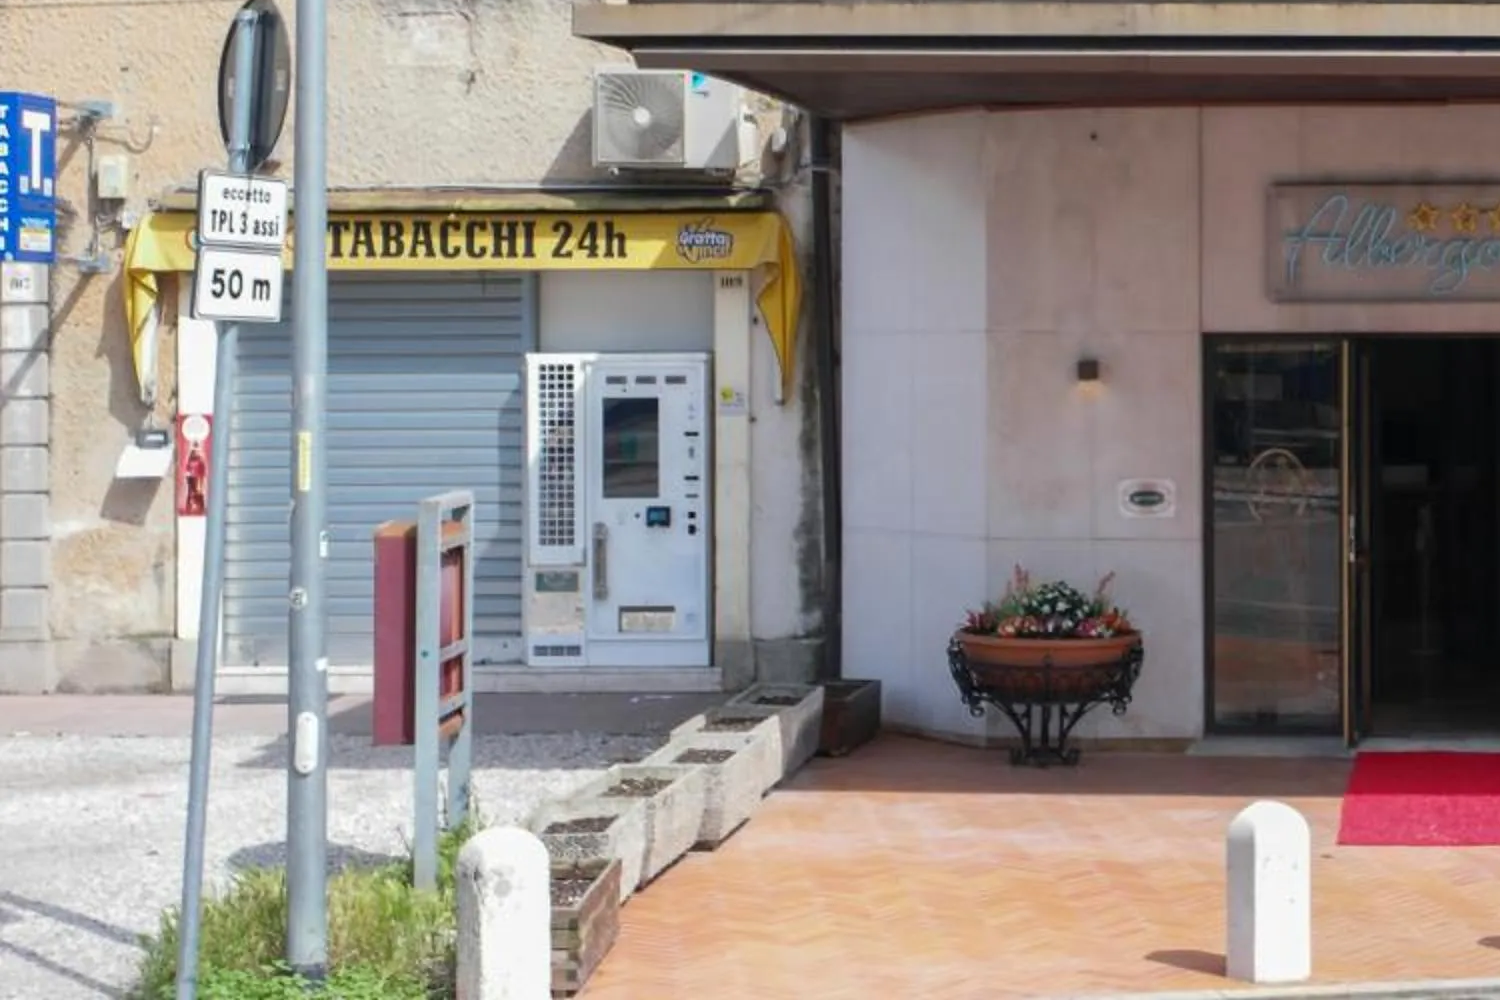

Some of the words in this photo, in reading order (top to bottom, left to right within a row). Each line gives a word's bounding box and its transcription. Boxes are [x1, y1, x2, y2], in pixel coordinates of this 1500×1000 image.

[222, 187, 272, 203] eccetto
[211, 209, 235, 234] TPL
[239, 212, 248, 234] 3
[253, 216, 280, 237] assi
[326, 219, 537, 260] TABACCHI
[551, 219, 627, 259] 24h
[211, 267, 243, 300] 50
[252, 277, 271, 301] m
